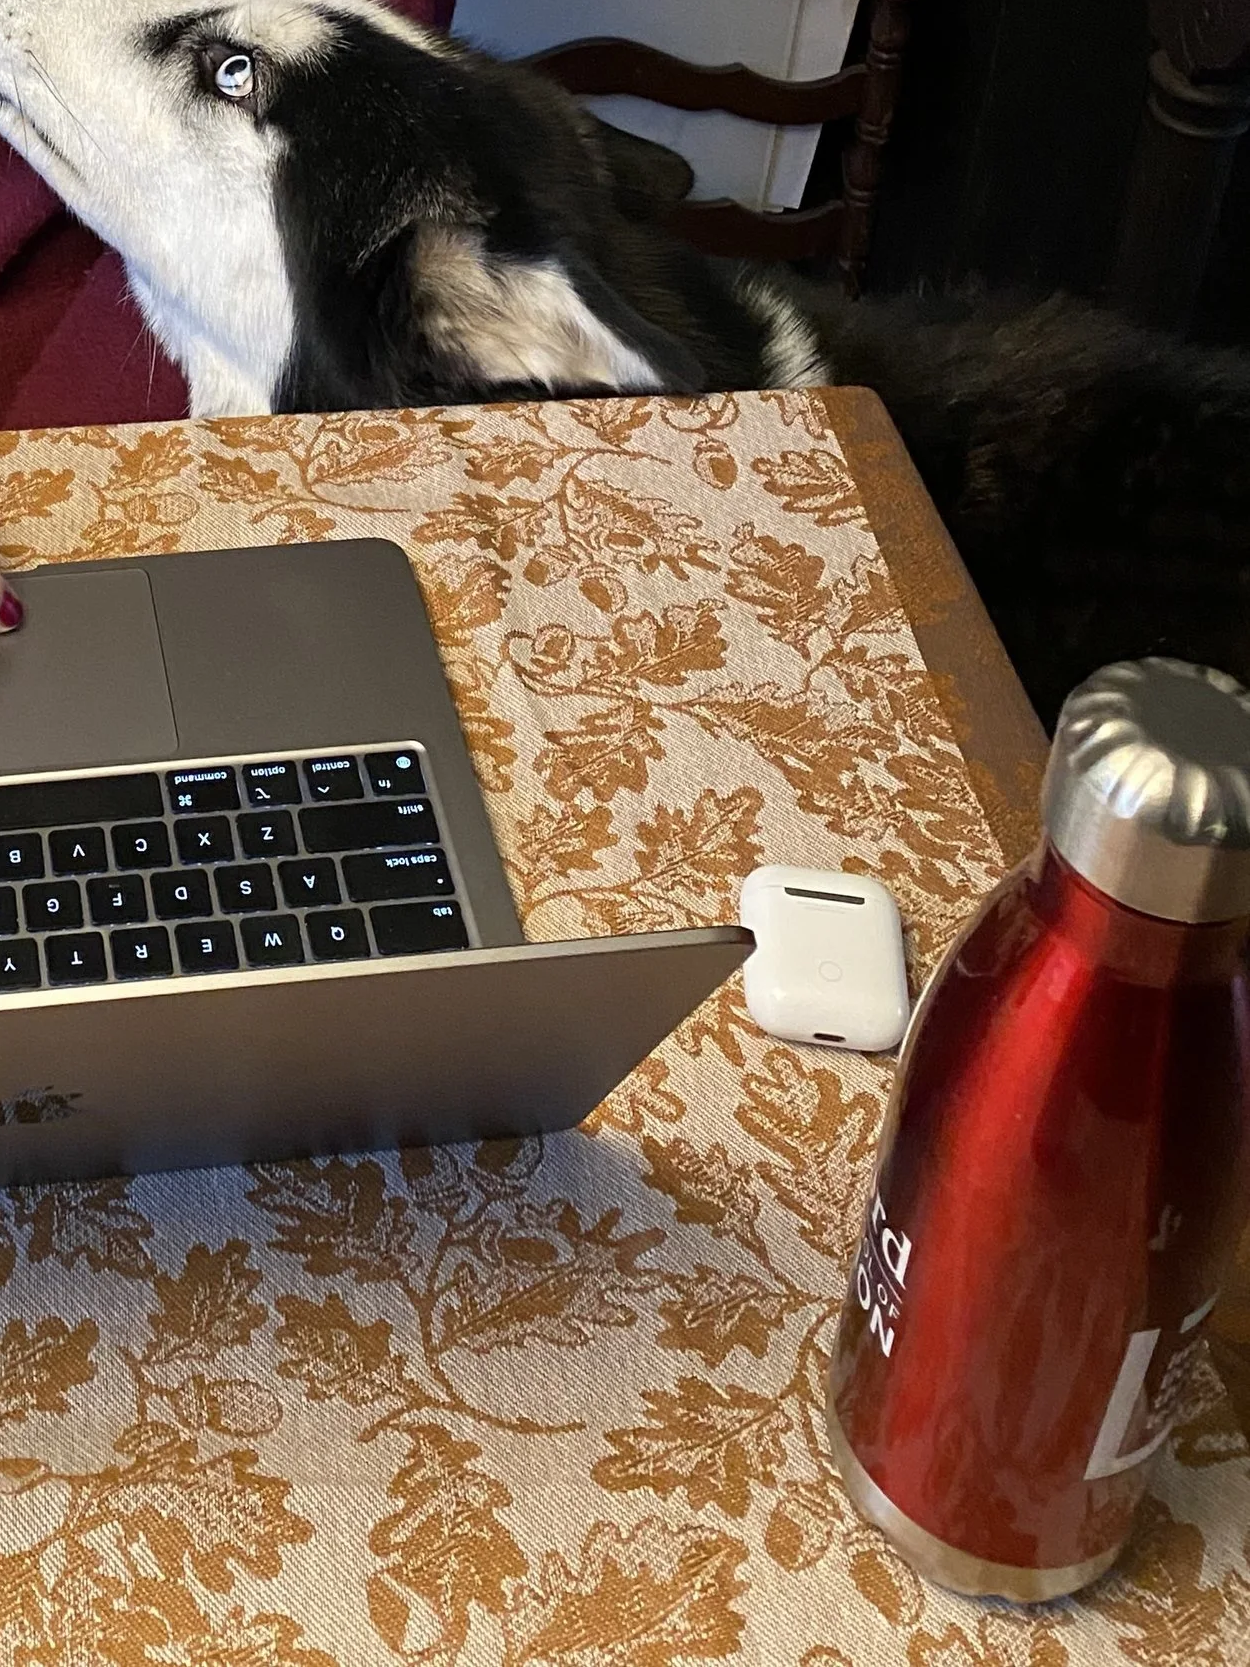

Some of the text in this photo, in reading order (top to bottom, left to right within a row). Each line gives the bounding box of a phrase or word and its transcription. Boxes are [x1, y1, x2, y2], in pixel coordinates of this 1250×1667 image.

[250, 765, 286, 777] option
[311, 760, 350, 773] control
[174, 771, 228, 785] command
[378, 779, 392, 789] fn
[397, 804, 424, 815] shift
[197, 832, 211, 847] X
[260, 826, 274, 841] Z
[72, 844, 86, 858] V
[135, 838, 148, 852] C
[8, 849, 22, 864] B
[385, 854, 438, 868] caps lock
[239, 880, 252, 895] S
[302, 875, 316, 889] A
[112, 892, 123, 907] F
[174, 886, 188, 901] D
[46, 898, 60, 913] G
[432, 906, 453, 917] tab
[264, 932, 283, 948] W
[330, 926, 345, 941] Q
[134, 944, 148, 959] R
[200, 938, 213, 953] E
[4, 957, 17, 972] Y
[71, 950, 84, 966] T
[857, 1263, 895, 1358] ON
